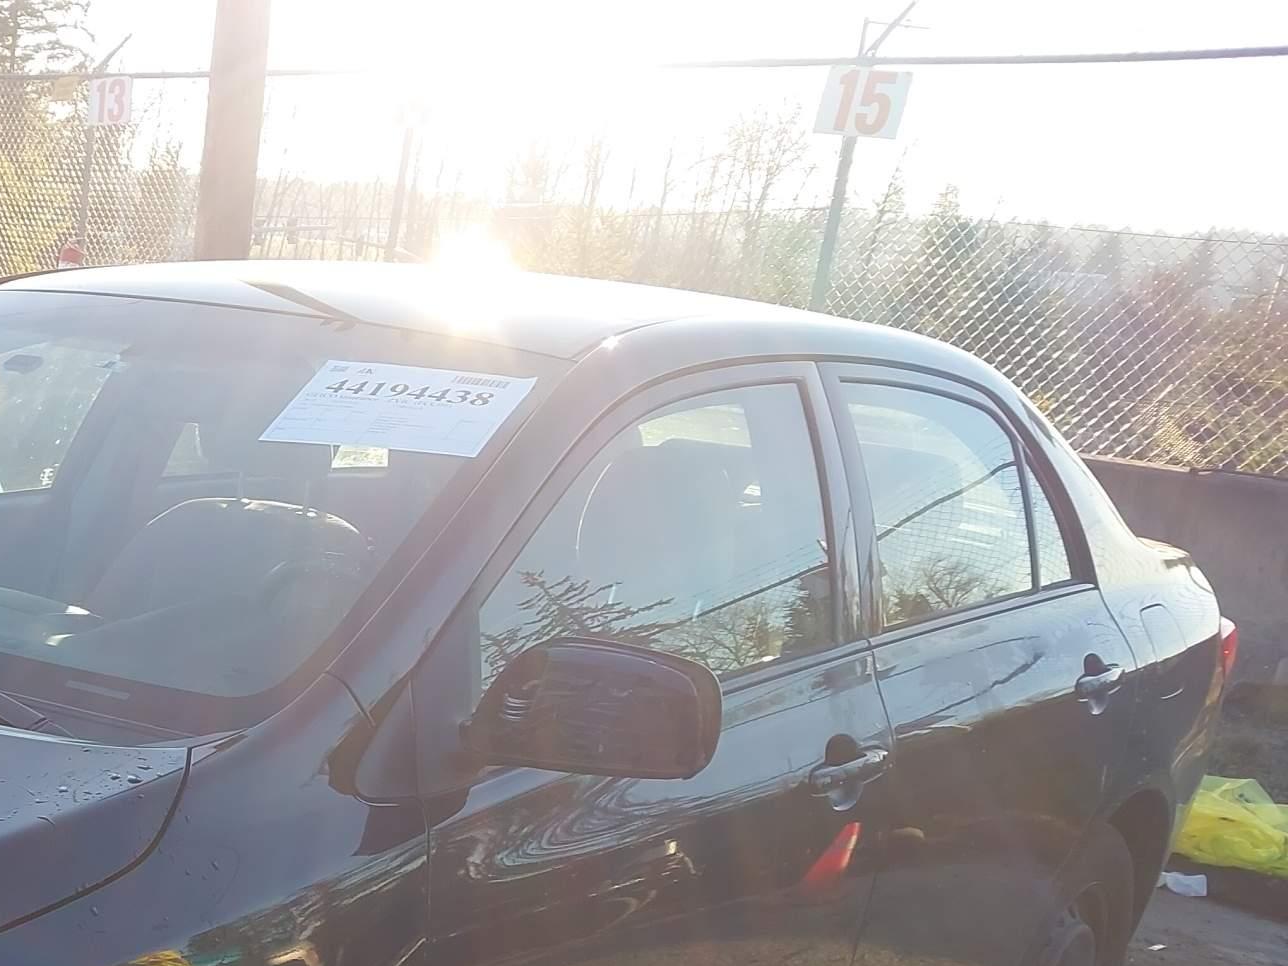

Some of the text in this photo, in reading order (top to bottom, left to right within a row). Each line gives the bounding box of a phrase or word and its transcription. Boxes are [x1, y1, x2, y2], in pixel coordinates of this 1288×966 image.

[96, 79, 125, 121] 13
[833, 69, 898, 134] 15
[326, 380, 493, 405] 44194438
